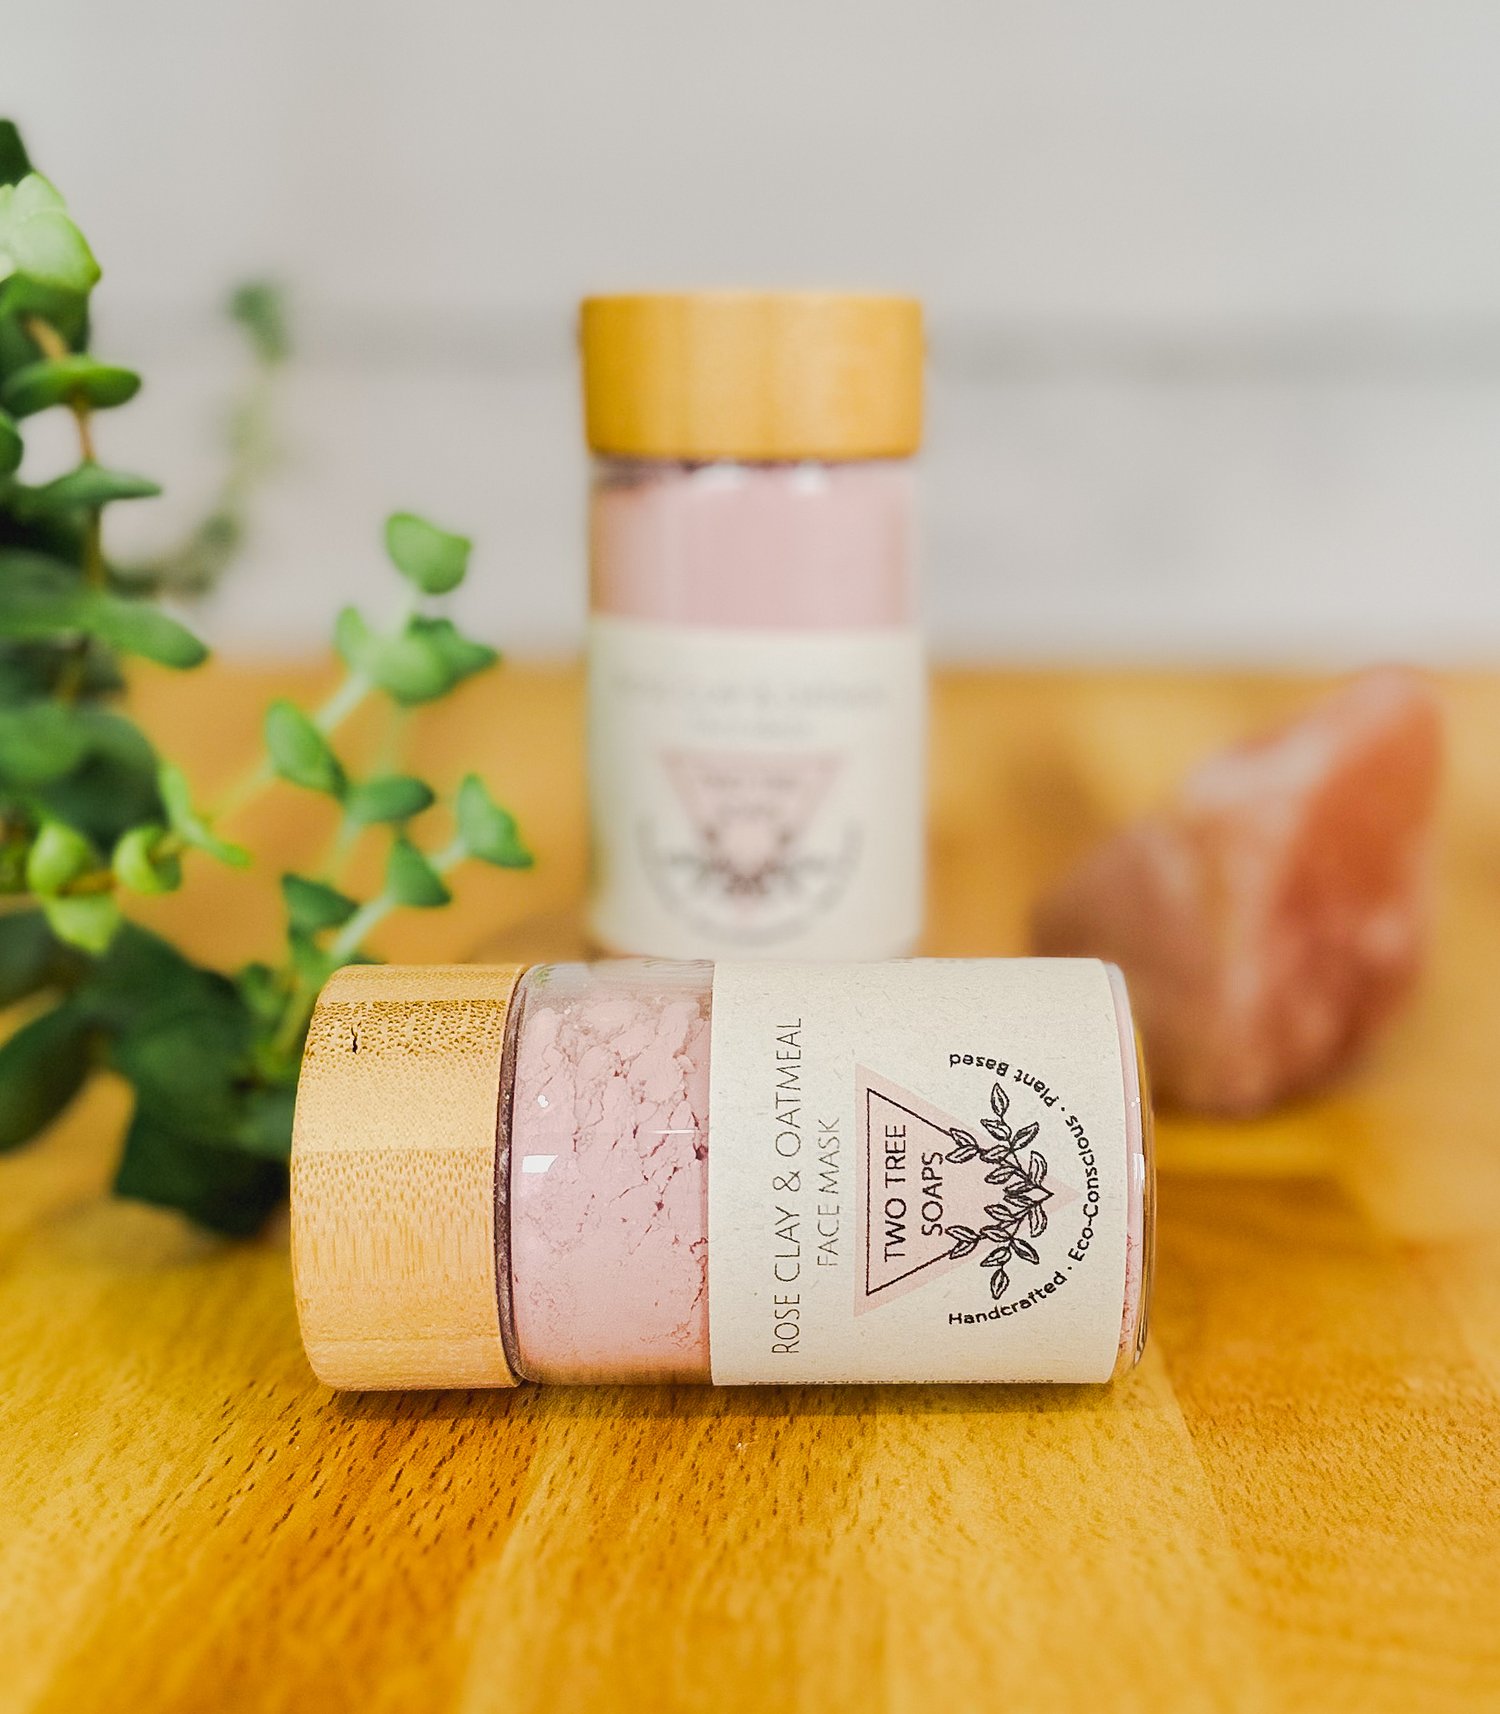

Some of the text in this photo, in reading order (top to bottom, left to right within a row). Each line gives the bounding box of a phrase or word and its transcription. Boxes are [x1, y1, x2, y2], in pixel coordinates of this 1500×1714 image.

[771, 1017, 802, 1355] ROSE CLAY & OATMEAL
[817, 1117, 840, 1267] FACE MASK
[884, 1124, 908, 1263] TWO TREE
[921, 1151, 944, 1237] SOAPS
[949, 1053, 1100, 1325] Handcrafted Eco-Conscious Plant Based
